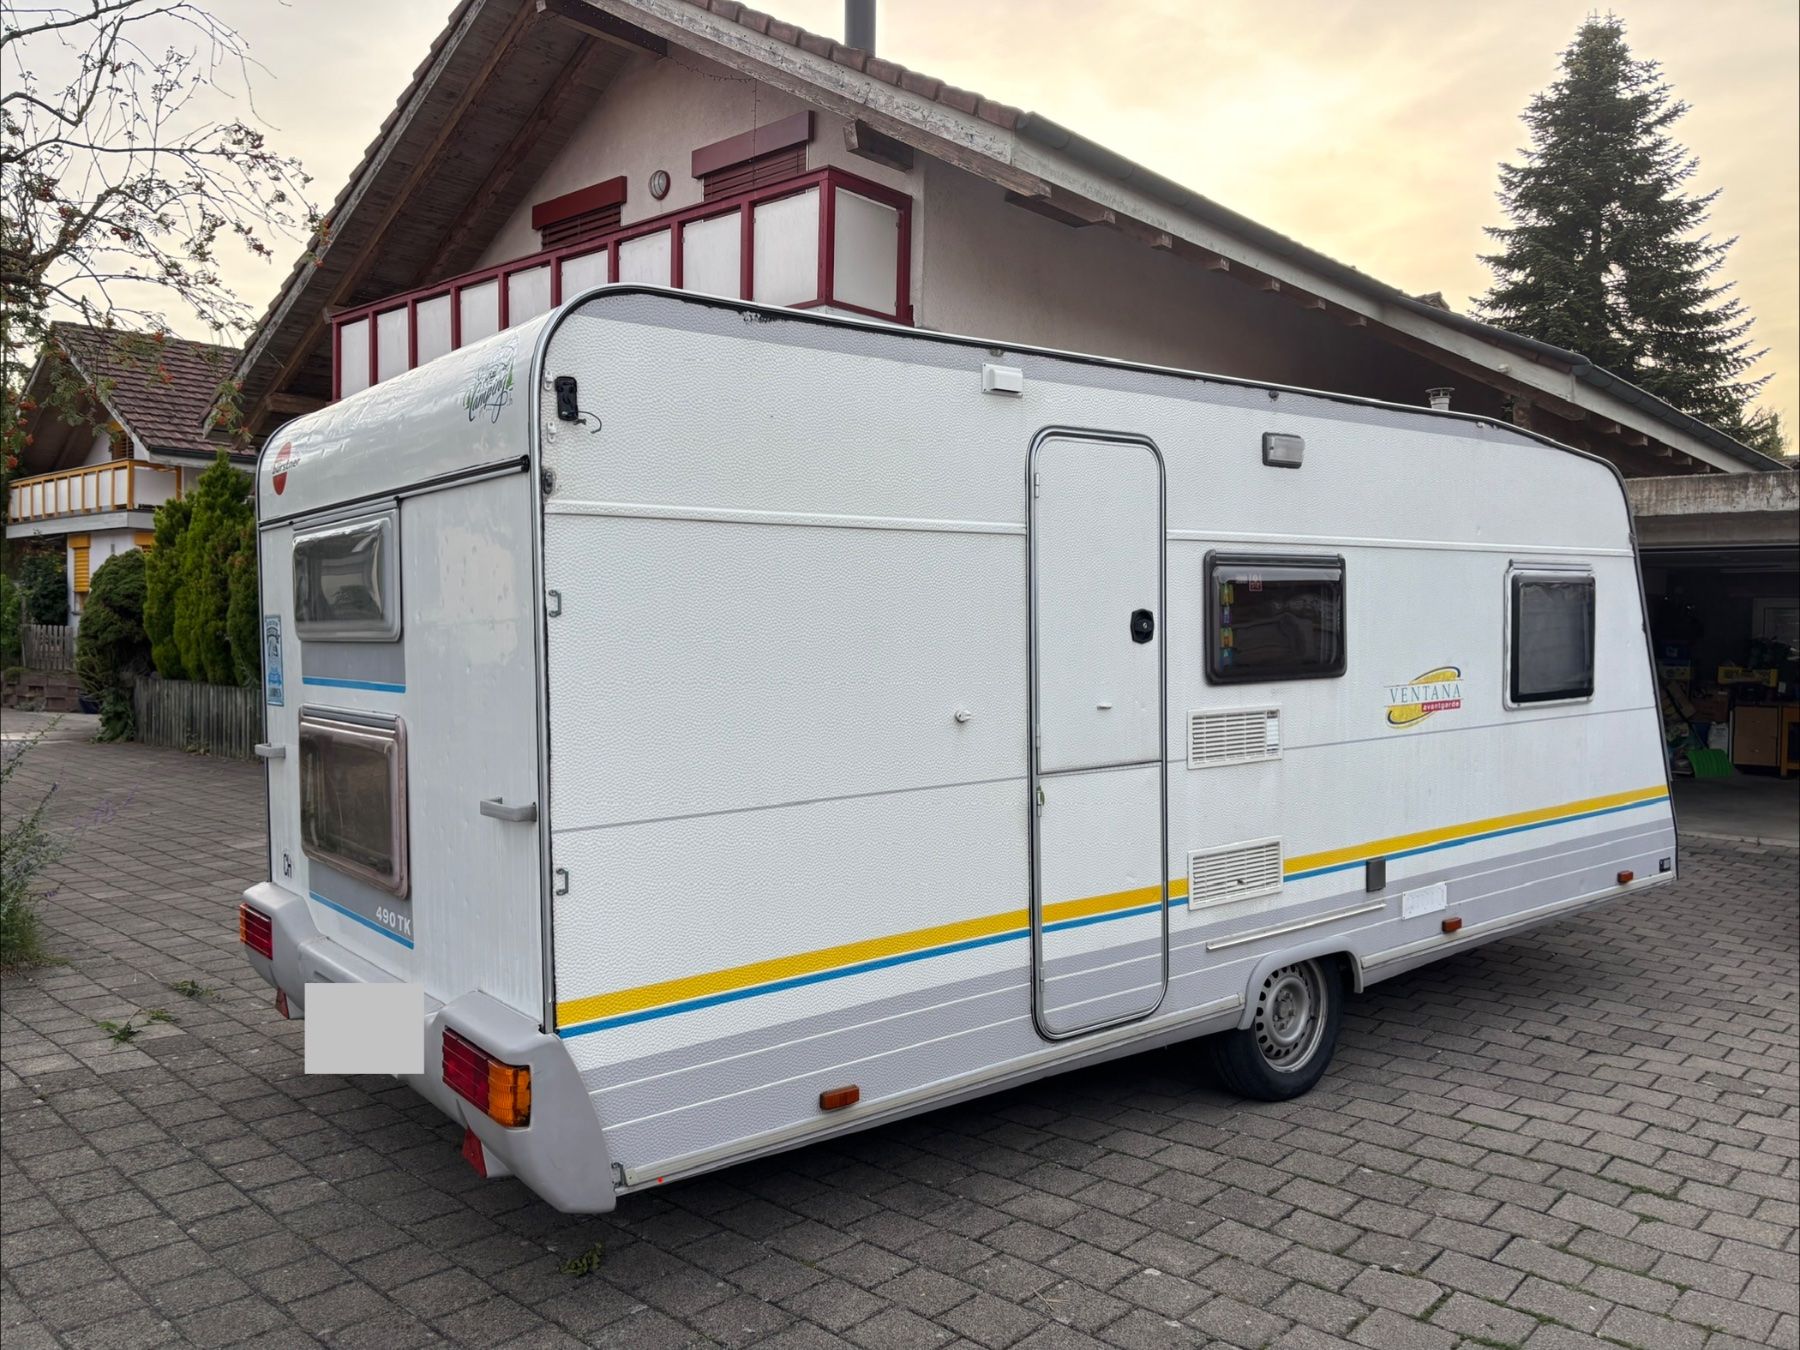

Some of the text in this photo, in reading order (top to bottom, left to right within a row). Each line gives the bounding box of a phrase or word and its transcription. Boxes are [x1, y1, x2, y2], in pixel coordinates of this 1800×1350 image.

[1390, 683, 1462, 704] VENTANA
[1422, 700, 1461, 712] avantgarde
[283, 853, 293, 879] CH
[376, 906, 411, 936] 490 TK
